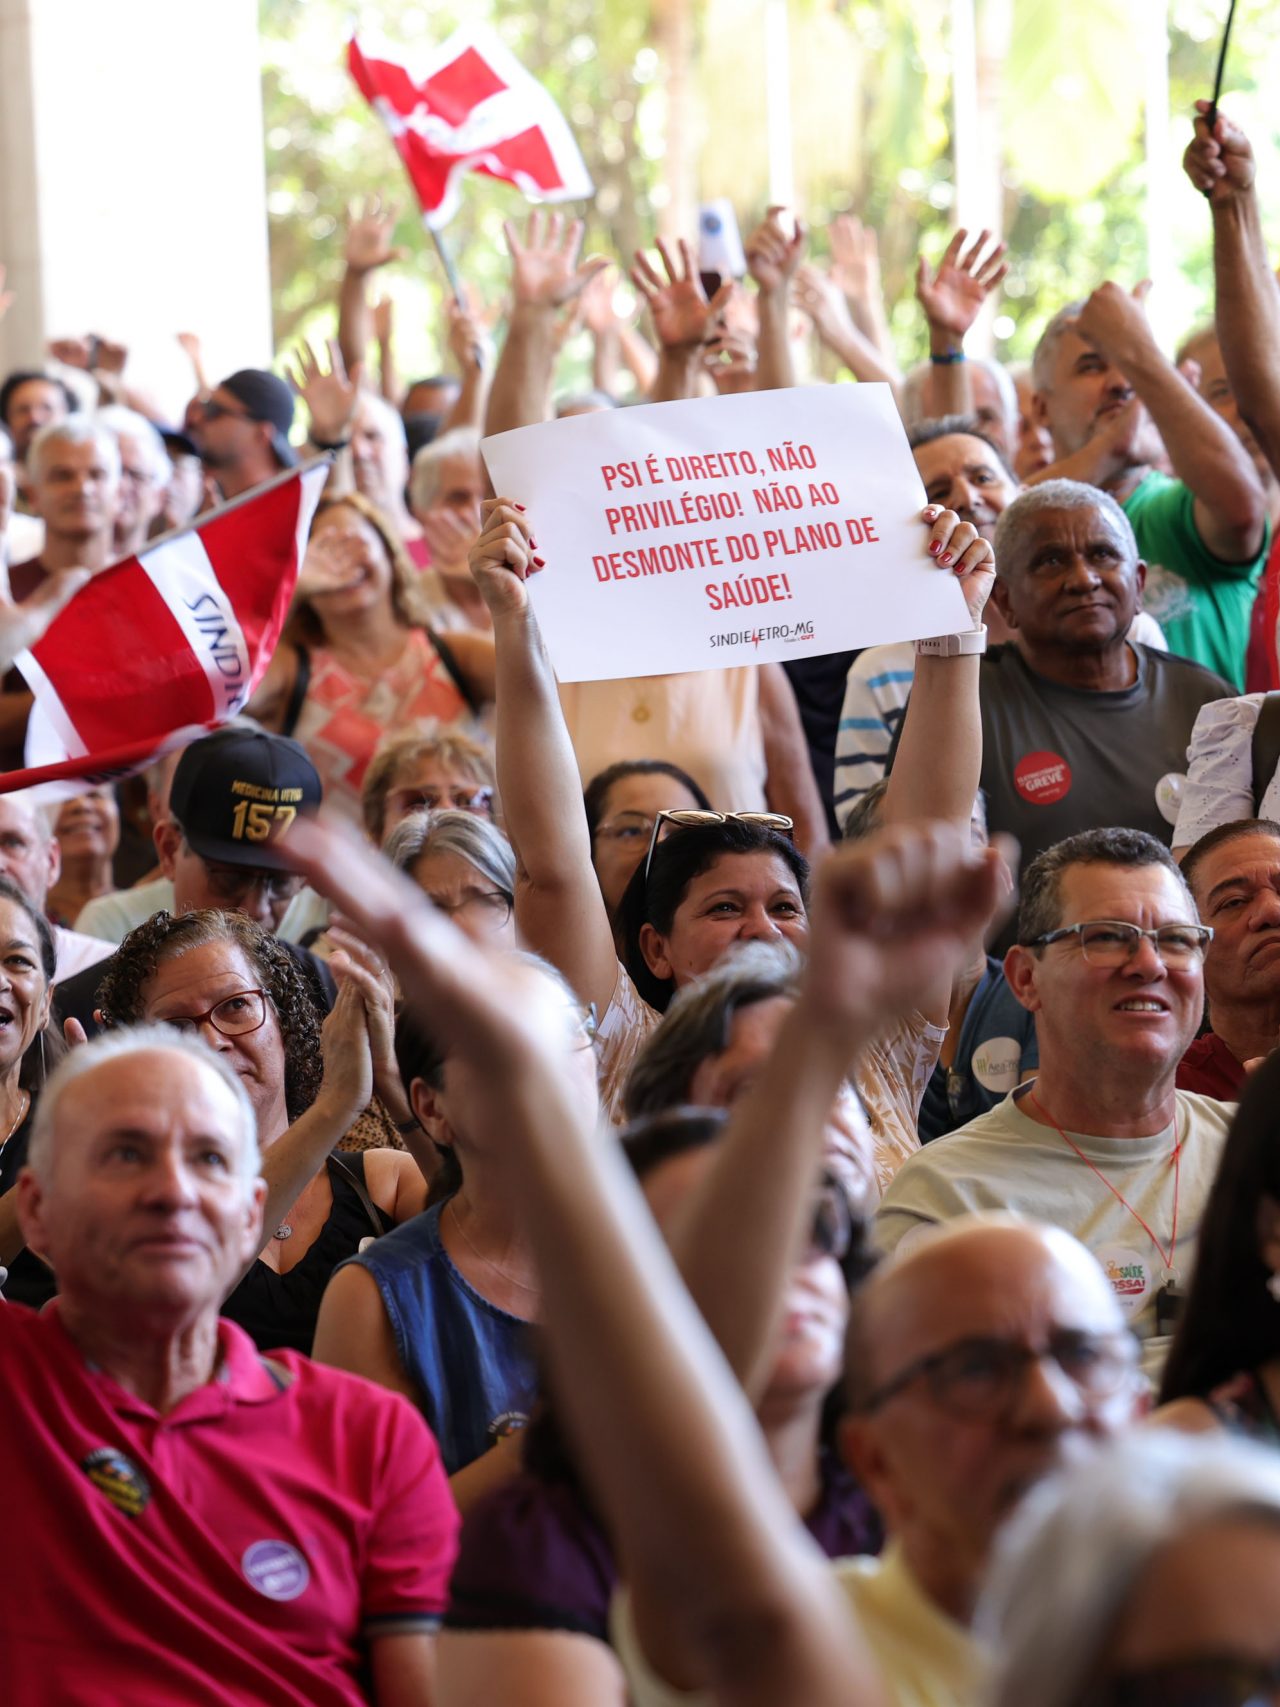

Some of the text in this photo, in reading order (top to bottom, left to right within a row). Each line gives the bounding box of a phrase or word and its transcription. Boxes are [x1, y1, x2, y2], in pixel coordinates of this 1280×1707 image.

[600, 441, 817, 491] PSI É DIREITO, NÃO
[605, 482, 840, 535] PRIVILÉGIO! NÃO AO
[591, 517, 880, 582] DESMONTE DO PLANO DE
[705, 573, 793, 611] SAÚDE!
[1024, 769, 1064, 792] GREVE
[231, 799, 297, 844] 157
